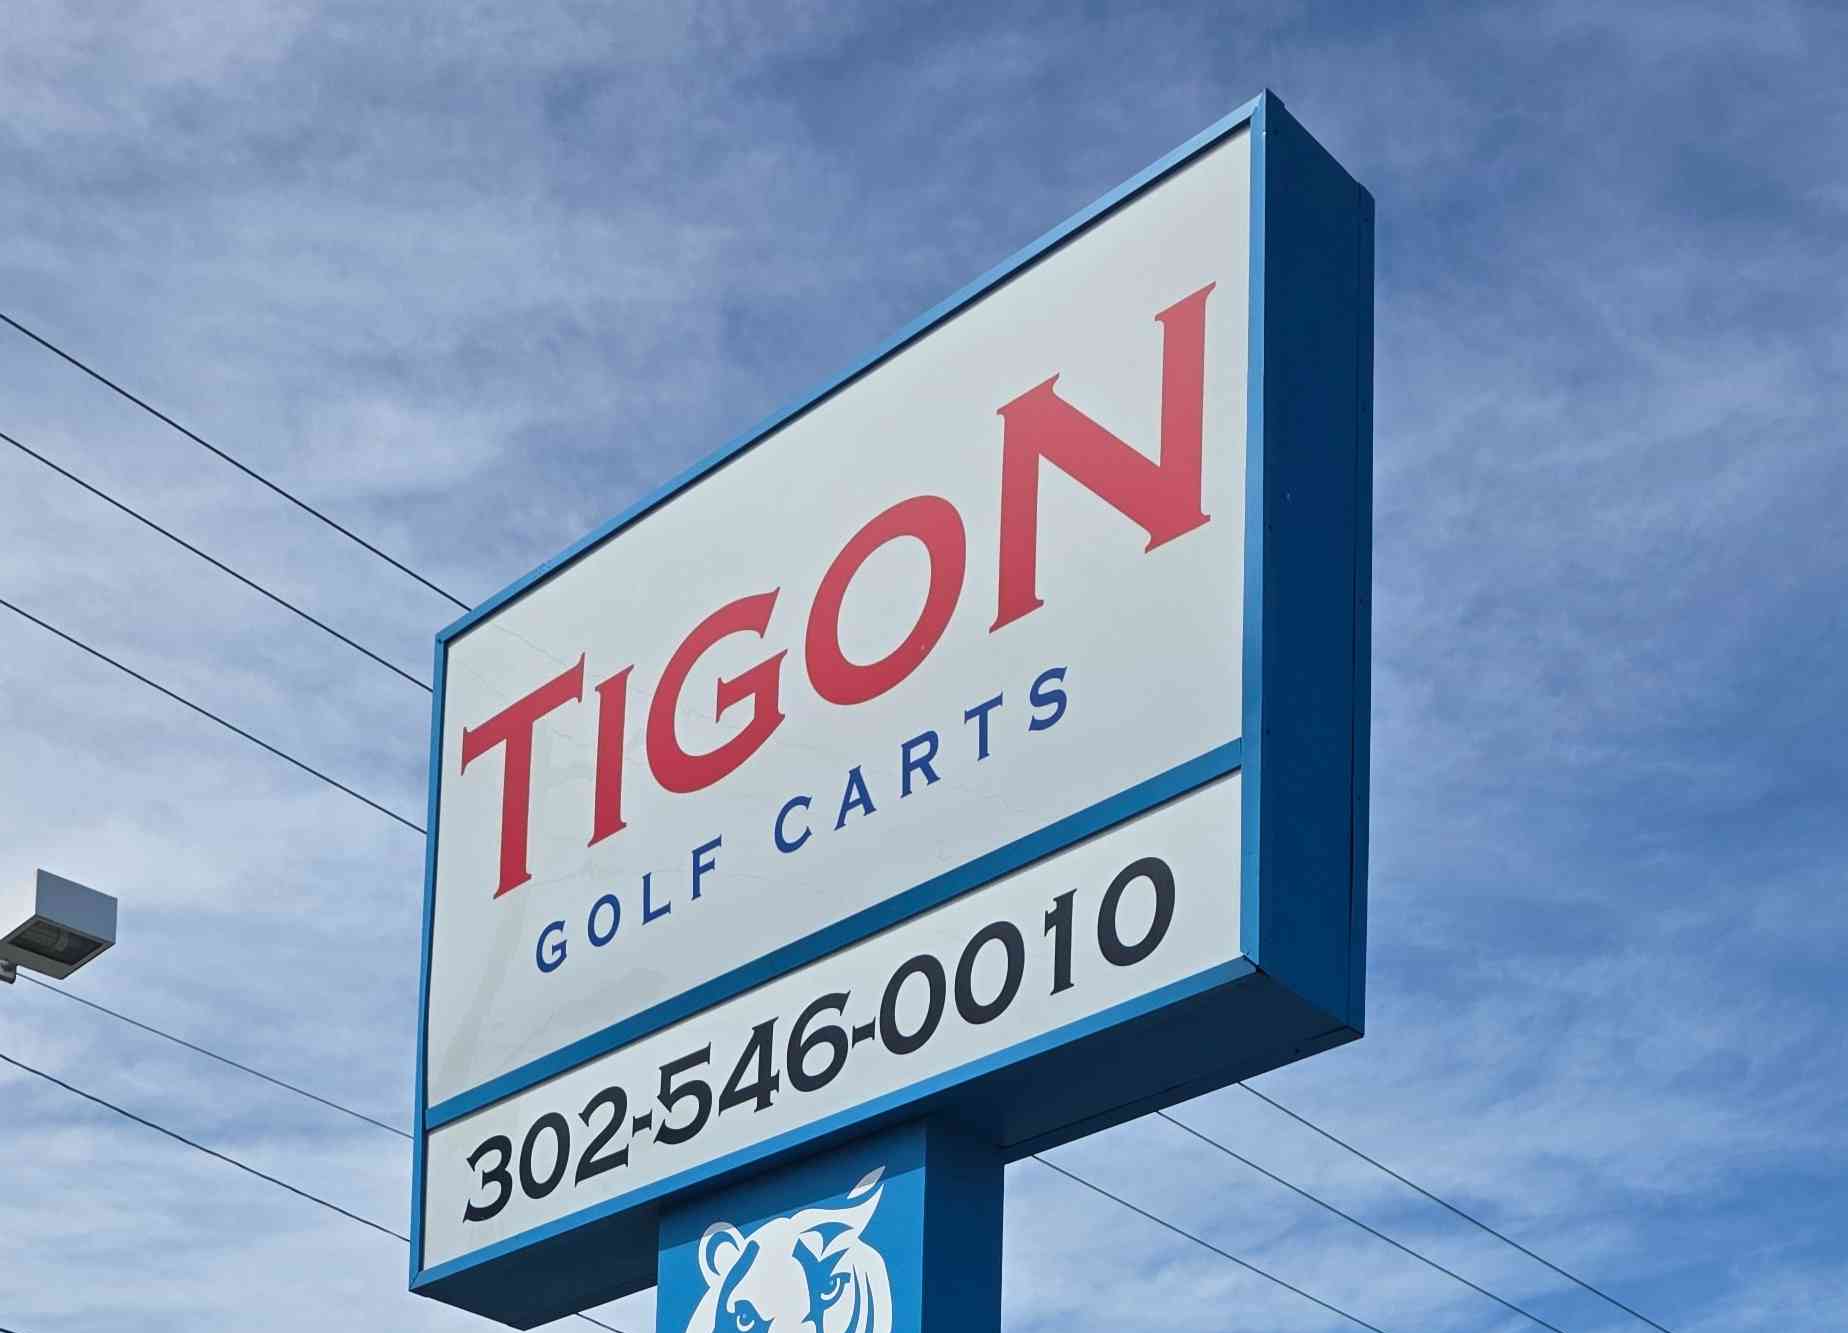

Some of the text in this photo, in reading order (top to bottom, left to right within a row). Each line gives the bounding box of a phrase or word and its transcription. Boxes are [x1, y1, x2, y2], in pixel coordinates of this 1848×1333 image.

[462, 283, 1217, 898] TIGON
[535, 667, 1068, 974] GOLF CARTS
[462, 856, 1176, 1224] 302-546-0010
